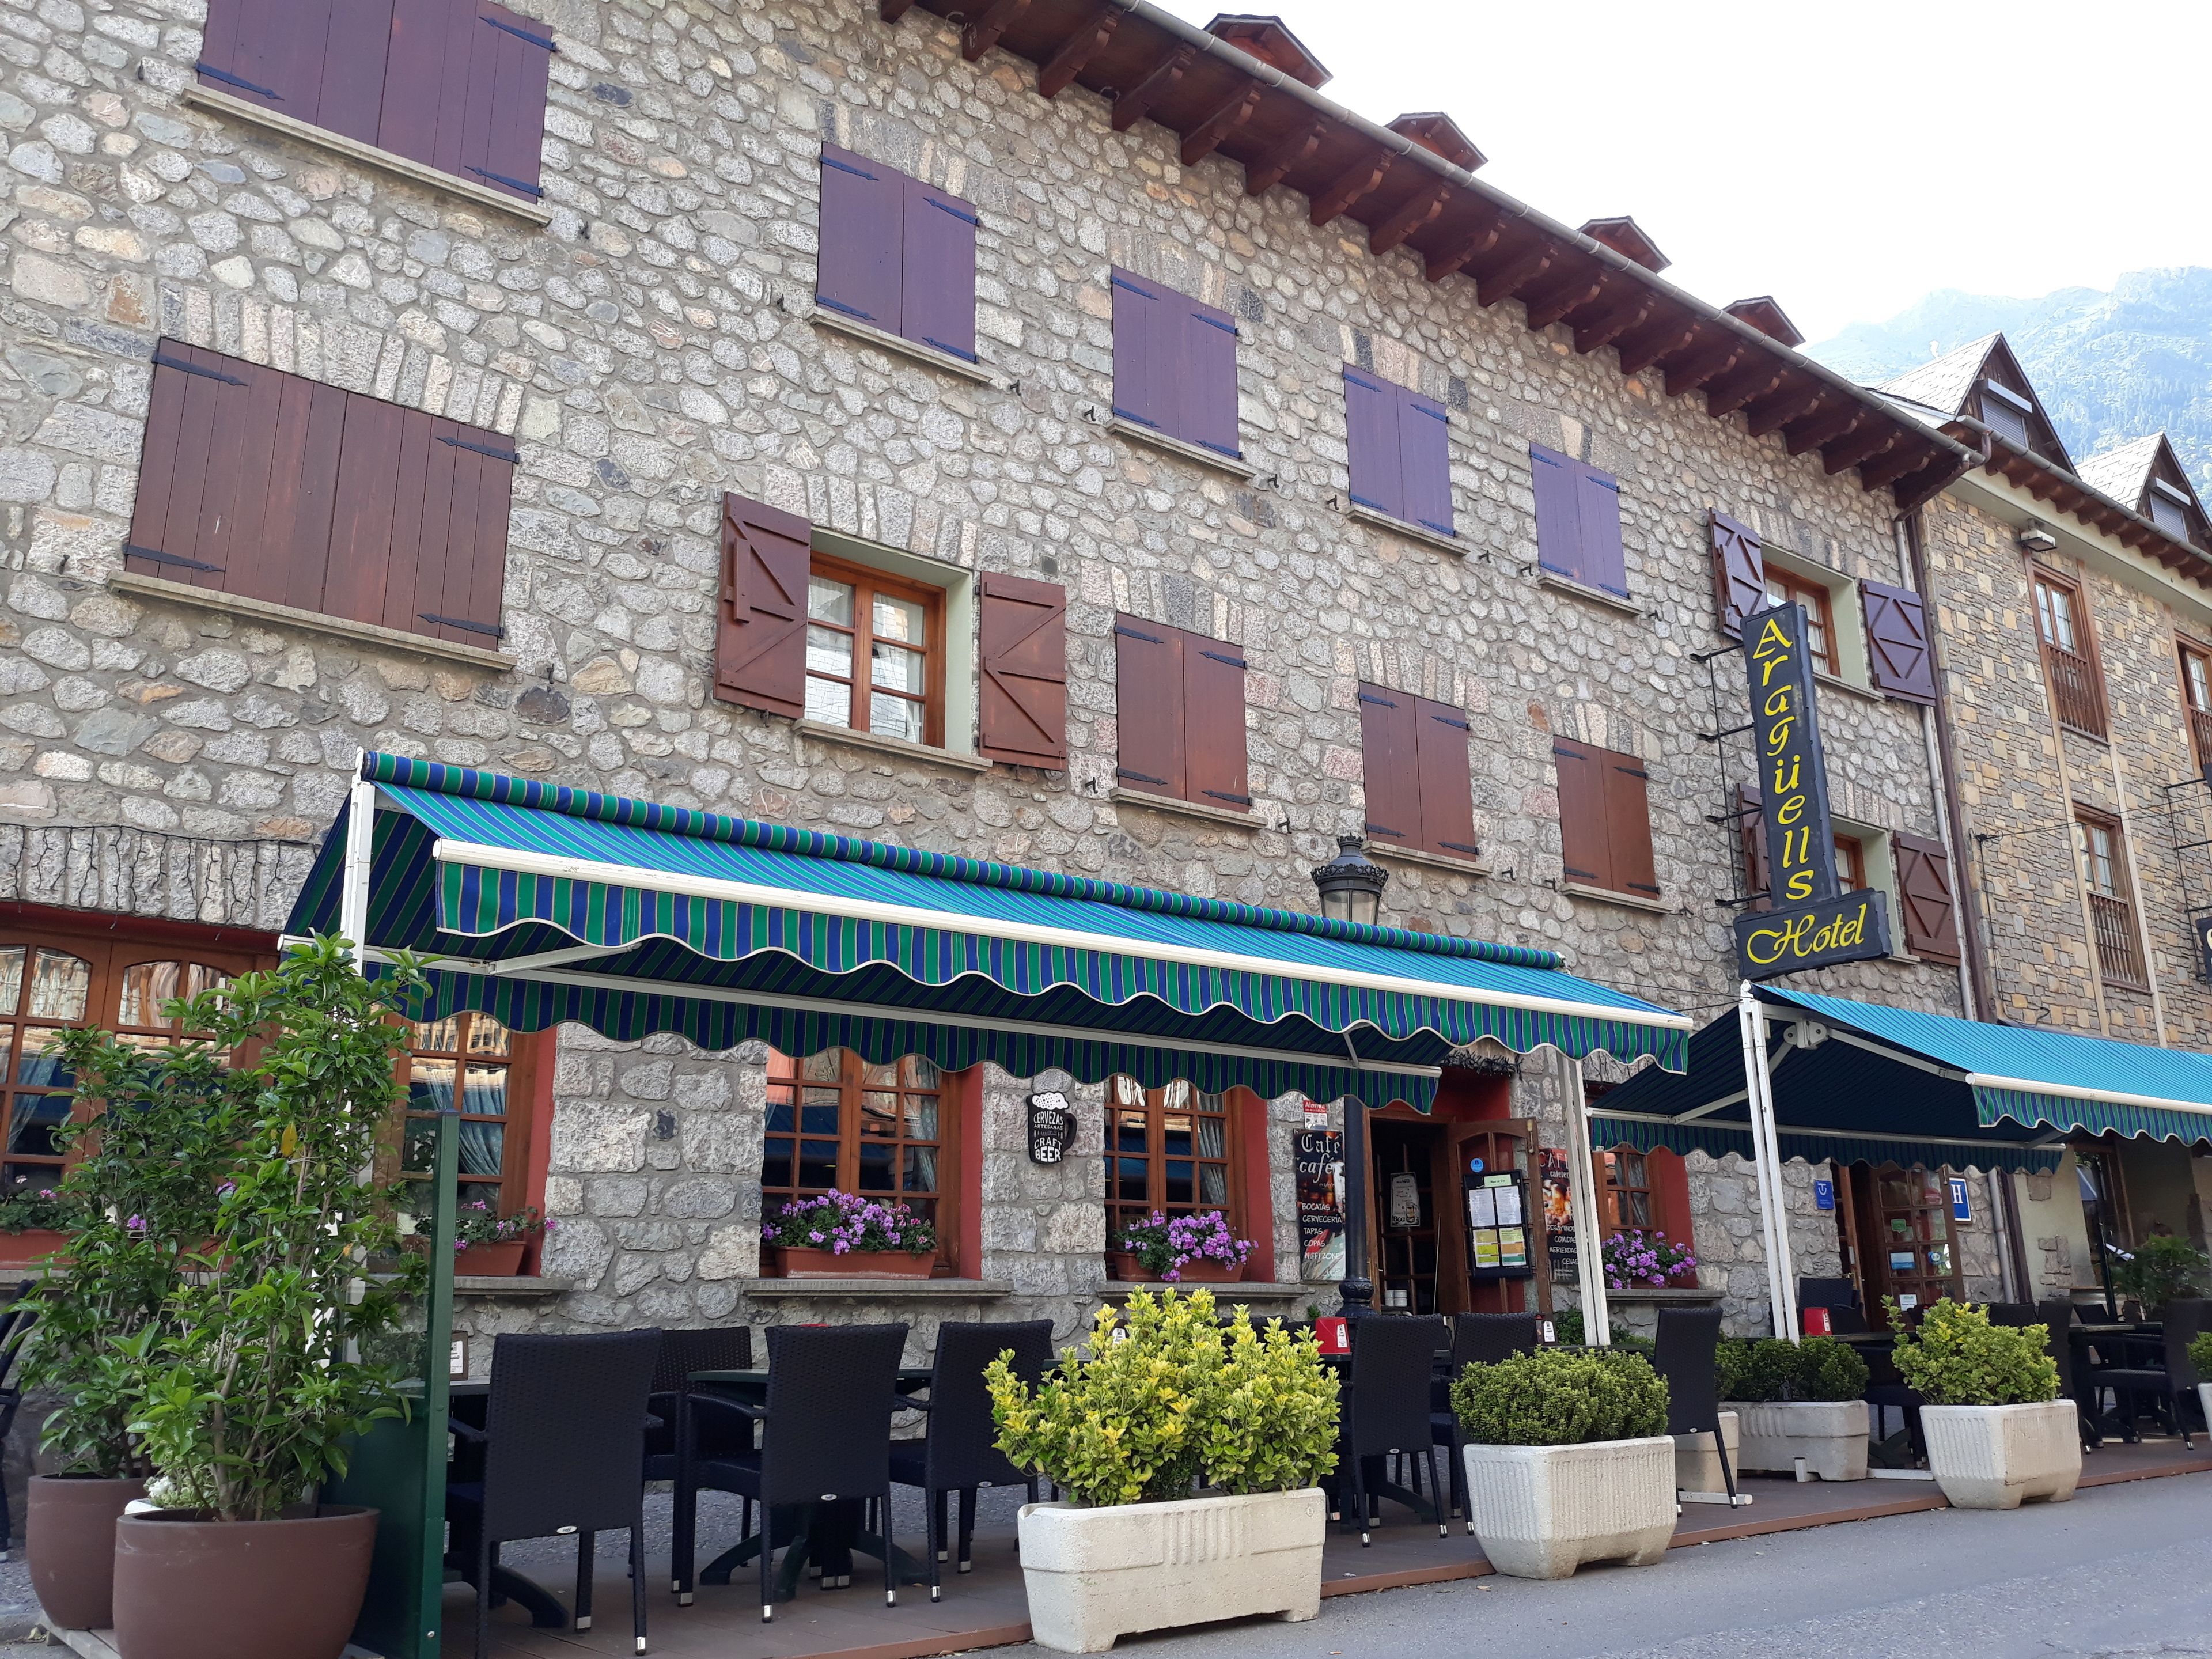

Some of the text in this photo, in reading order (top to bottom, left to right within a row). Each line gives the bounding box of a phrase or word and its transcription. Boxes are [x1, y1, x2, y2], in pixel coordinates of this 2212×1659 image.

[1752, 618, 1814, 900] Aragüells
[1747, 903, 1867, 964] Hotel
[1305, 1101, 1326, 1109] Alarma
[1033, 1111, 1064, 1126] CERVEZAS
[1034, 1137, 1062, 1151] CRAFT
[1301, 1133, 1340, 1154] Café
[1035, 1146, 1062, 1162] BEER
[1299, 1153, 1334, 1184] café
[1951, 1184, 1964, 1204] H
